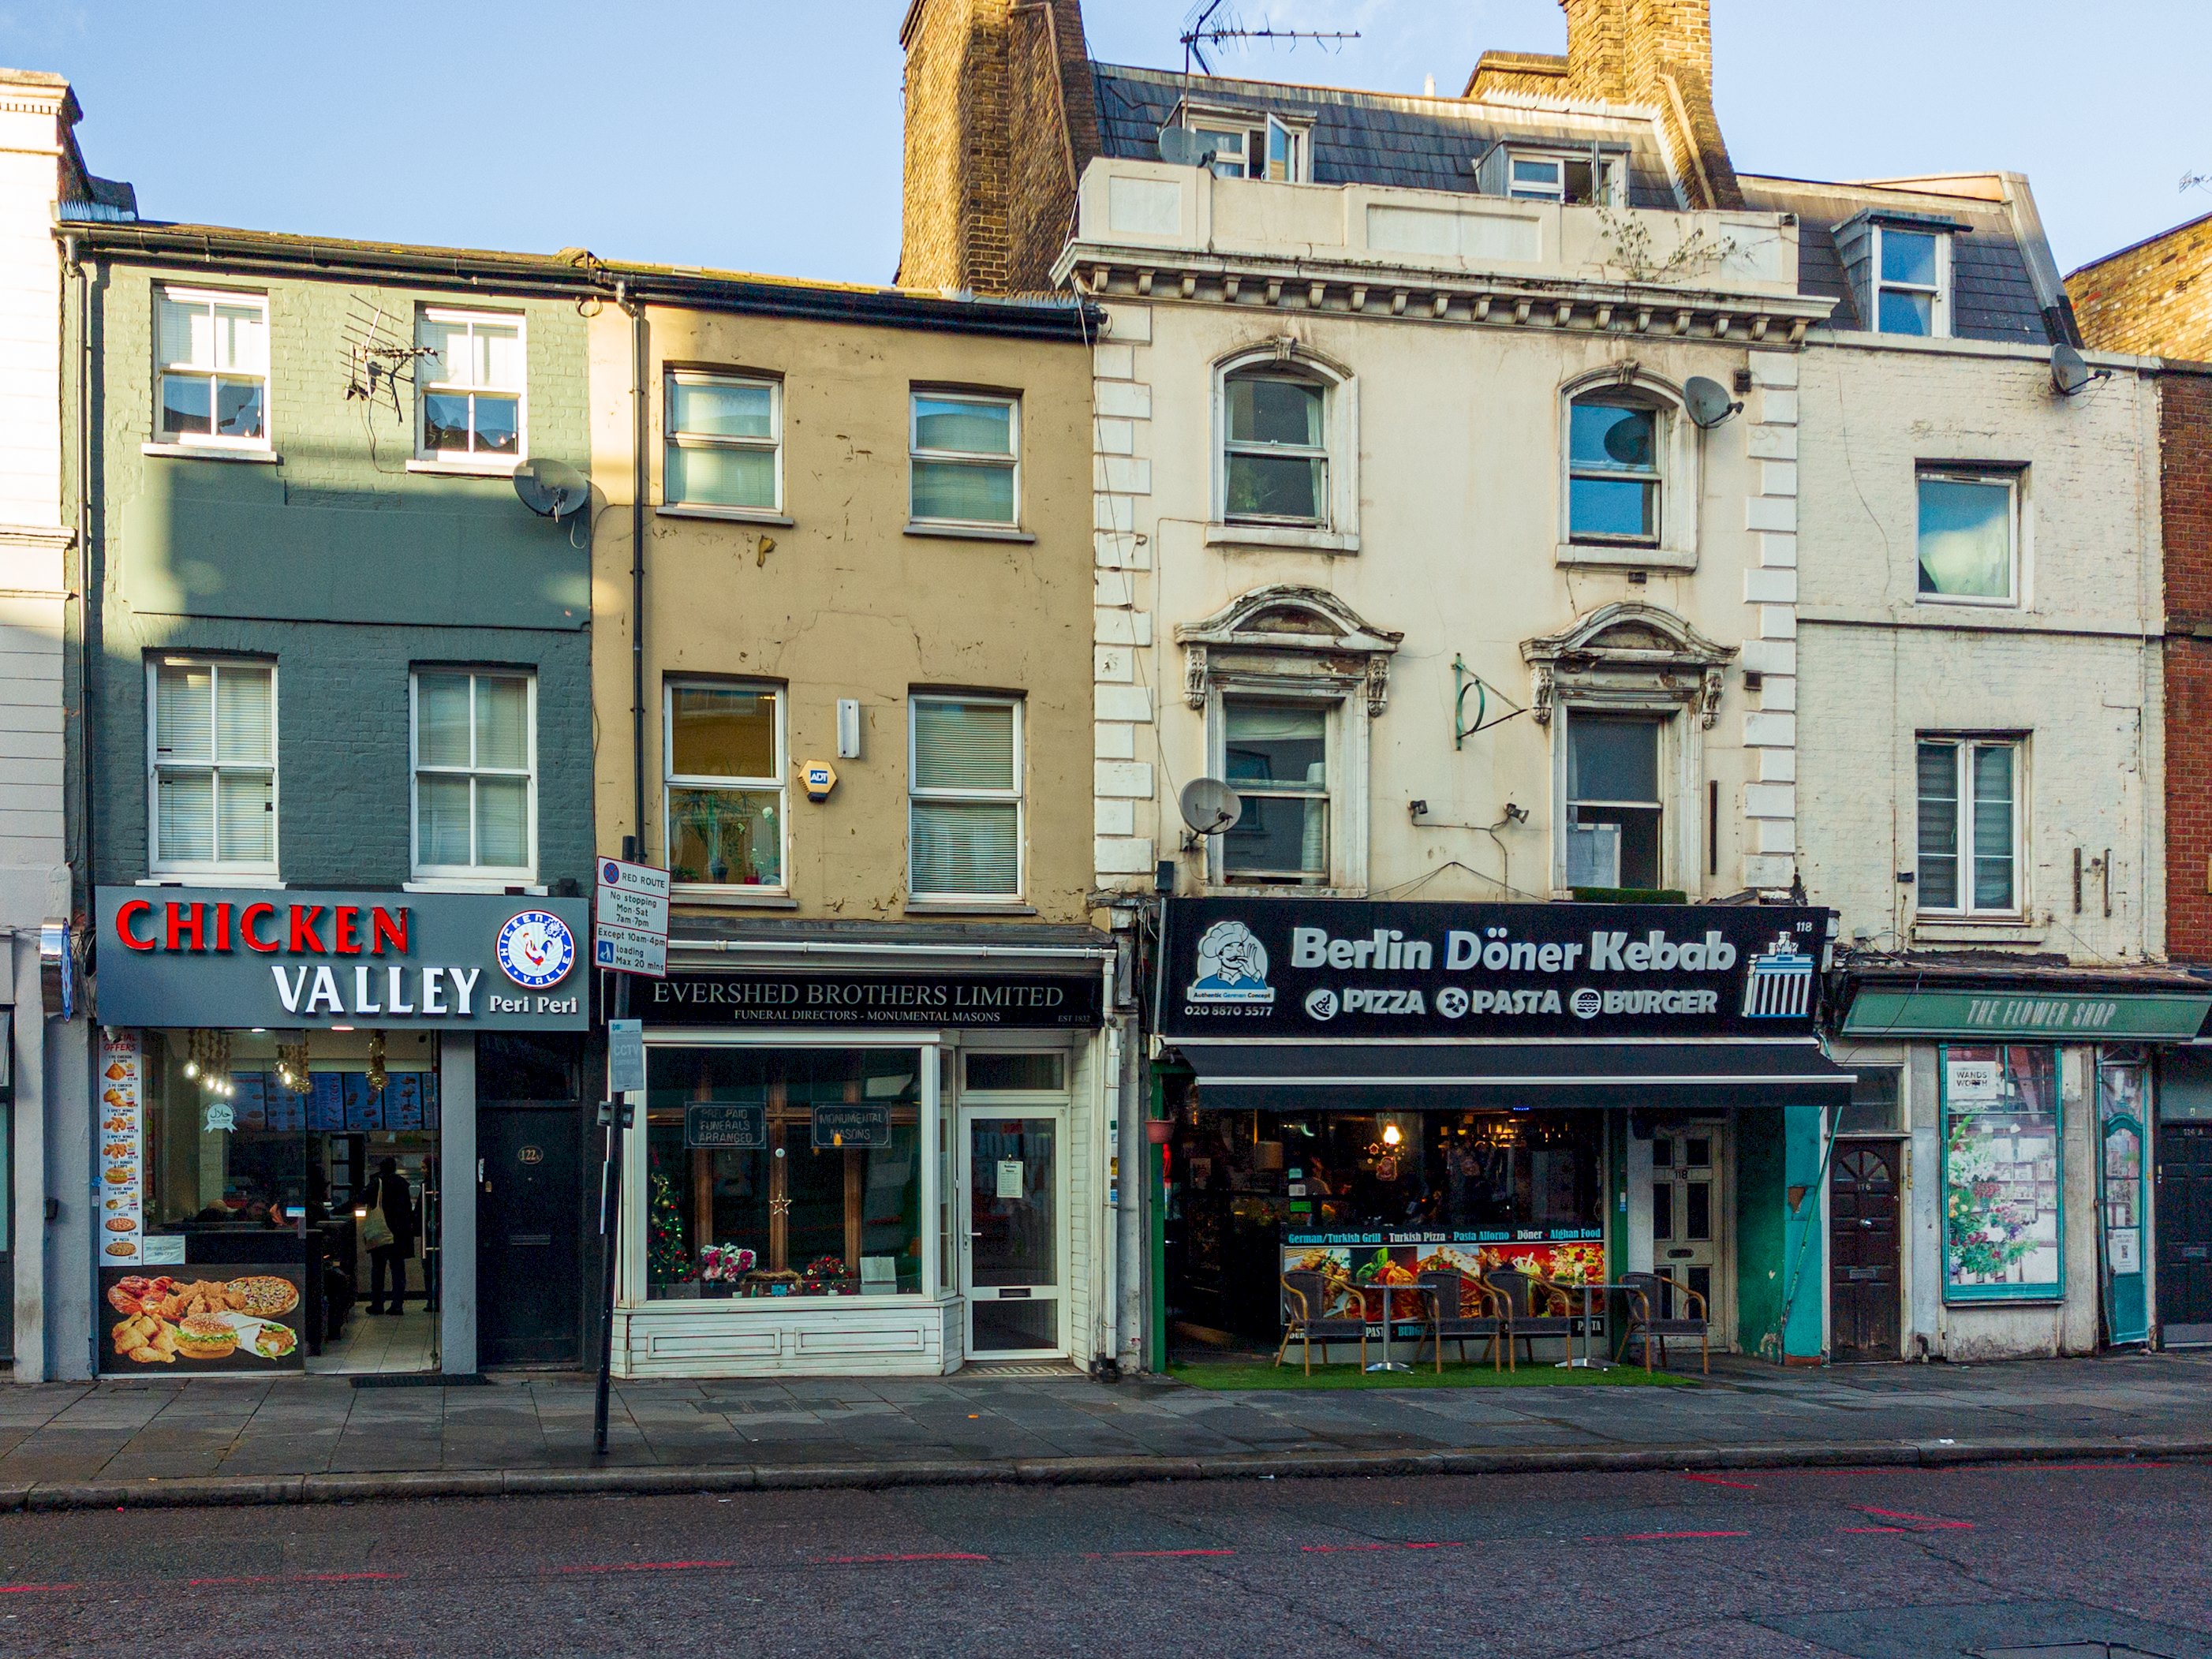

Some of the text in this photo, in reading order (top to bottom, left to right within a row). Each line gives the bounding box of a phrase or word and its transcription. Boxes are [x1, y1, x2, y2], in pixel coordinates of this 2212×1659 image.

[811, 772, 828, 782] ADT
[622, 872, 666, 888] RED ROUTE
[611, 891, 657, 909] No stopping
[115, 899, 409, 955] CHICKEN
[1795, 921, 1813, 932] 118
[598, 928, 625, 940] Except
[500, 914, 572, 985] CHICKEN VALLEY
[616, 945, 644, 958] loading
[1291, 927, 1736, 973] Berlin Döner Kebab
[615, 956, 664, 971] Max 20 mins
[271, 965, 481, 1014] VALLEY
[653, 982, 1063, 1007] EVERSHED BROTHERS LIMITED
[489, 995, 577, 1014] Peri Peri
[1343, 988, 1718, 1014] PIZZA PASTA BURGER
[734, 1010, 788, 1019] FUNERAL
[792, 1010, 858, 1021] DIRECTORS
[867, 1011, 950, 1022] MONUMENTAL
[951, 1012, 1000, 1022] MASONS
[1184, 1005, 1273, 1016] 020 8870 5577
[1967, 1000, 2117, 1027] THE FLOWER SHOP
[103, 1043, 136, 1052] OFFERS
[614, 1044, 639, 1056] CCTV
[701, 1120, 751, 1131] FUNERALS
[820, 1112, 883, 1125] MONUMENTAL
[699, 1132, 753, 1143] ARRANGED
[830, 1129, 871, 1141] MASONS
[1674, 1170, 1688, 1179] 118
[1288, 1233, 1360, 1243] German/Turkish
[1362, 1232, 1381, 1243] Grill
[1388, 1231, 1421, 1243] Turkish
[1423, 1231, 1445, 1242] Pizza
[1453, 1231, 1477, 1242] Pasta
[1517, 1230, 1543, 1240] Döner
[1550, 1229, 1579, 1240] Afghan
[1581, 1227, 1601, 1239] Food
[1366, 1327, 1386, 1338] PAST
[1577, 1321, 1601, 1331] PTA
